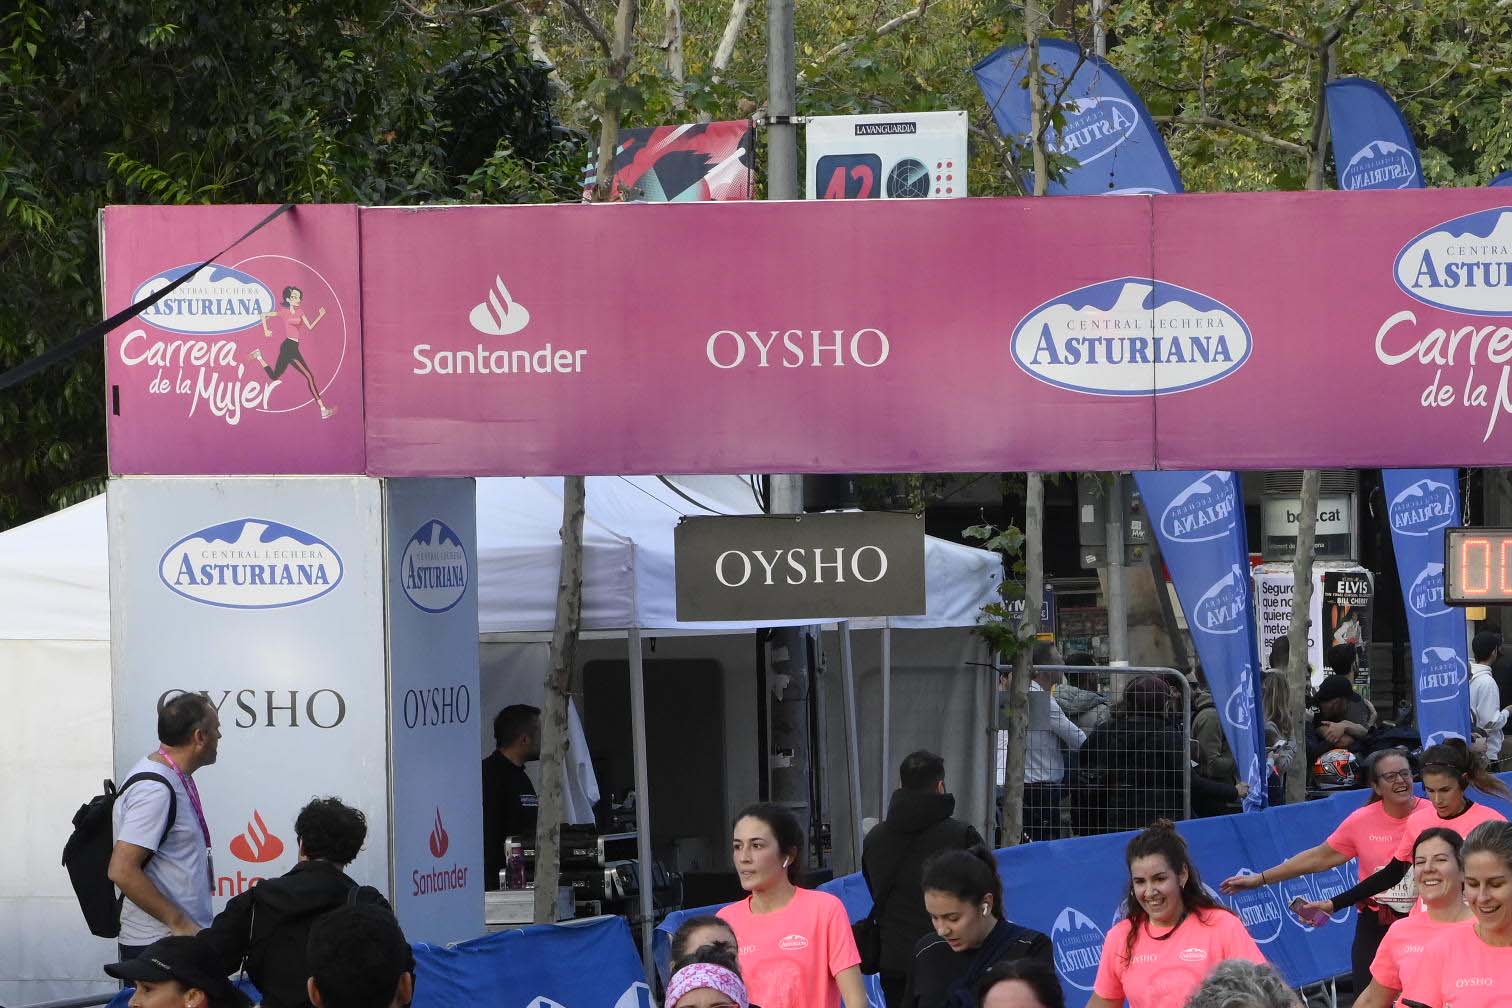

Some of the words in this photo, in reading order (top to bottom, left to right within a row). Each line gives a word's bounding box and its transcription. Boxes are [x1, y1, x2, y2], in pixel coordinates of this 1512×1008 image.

[856, 126, 866, 134] LA
[866, 124, 915, 134] VANGUARDIA
[1067, 318, 1143, 331] CENTRAL
[119, 329, 238, 368] Carrera
[412, 342, 587, 376] Santander
[706, 328, 890, 369] OYSHO
[1030, 322, 1233, 366] ASTURIANA
[149, 368, 171, 394] de
[175, 367, 192, 394] la
[188, 363, 282, 426] Mujer
[1421, 368, 1456, 407] de
[1463, 366, 1488, 407] la
[175, 552, 330, 587] ASTURIANA
[202, 549, 261, 559] CENTRAL
[265, 549, 324, 559] LECHERA
[406, 552, 465, 590] ASTURIANA
[714, 545, 889, 587] OYSHO
[1263, 599, 1278, 608] que
[1337, 581, 1368, 594] ELVIS
[404, 684, 471, 730] OYSHO
[412, 864, 469, 898] Santander
[1456, 977, 1494, 988] OYSHO
